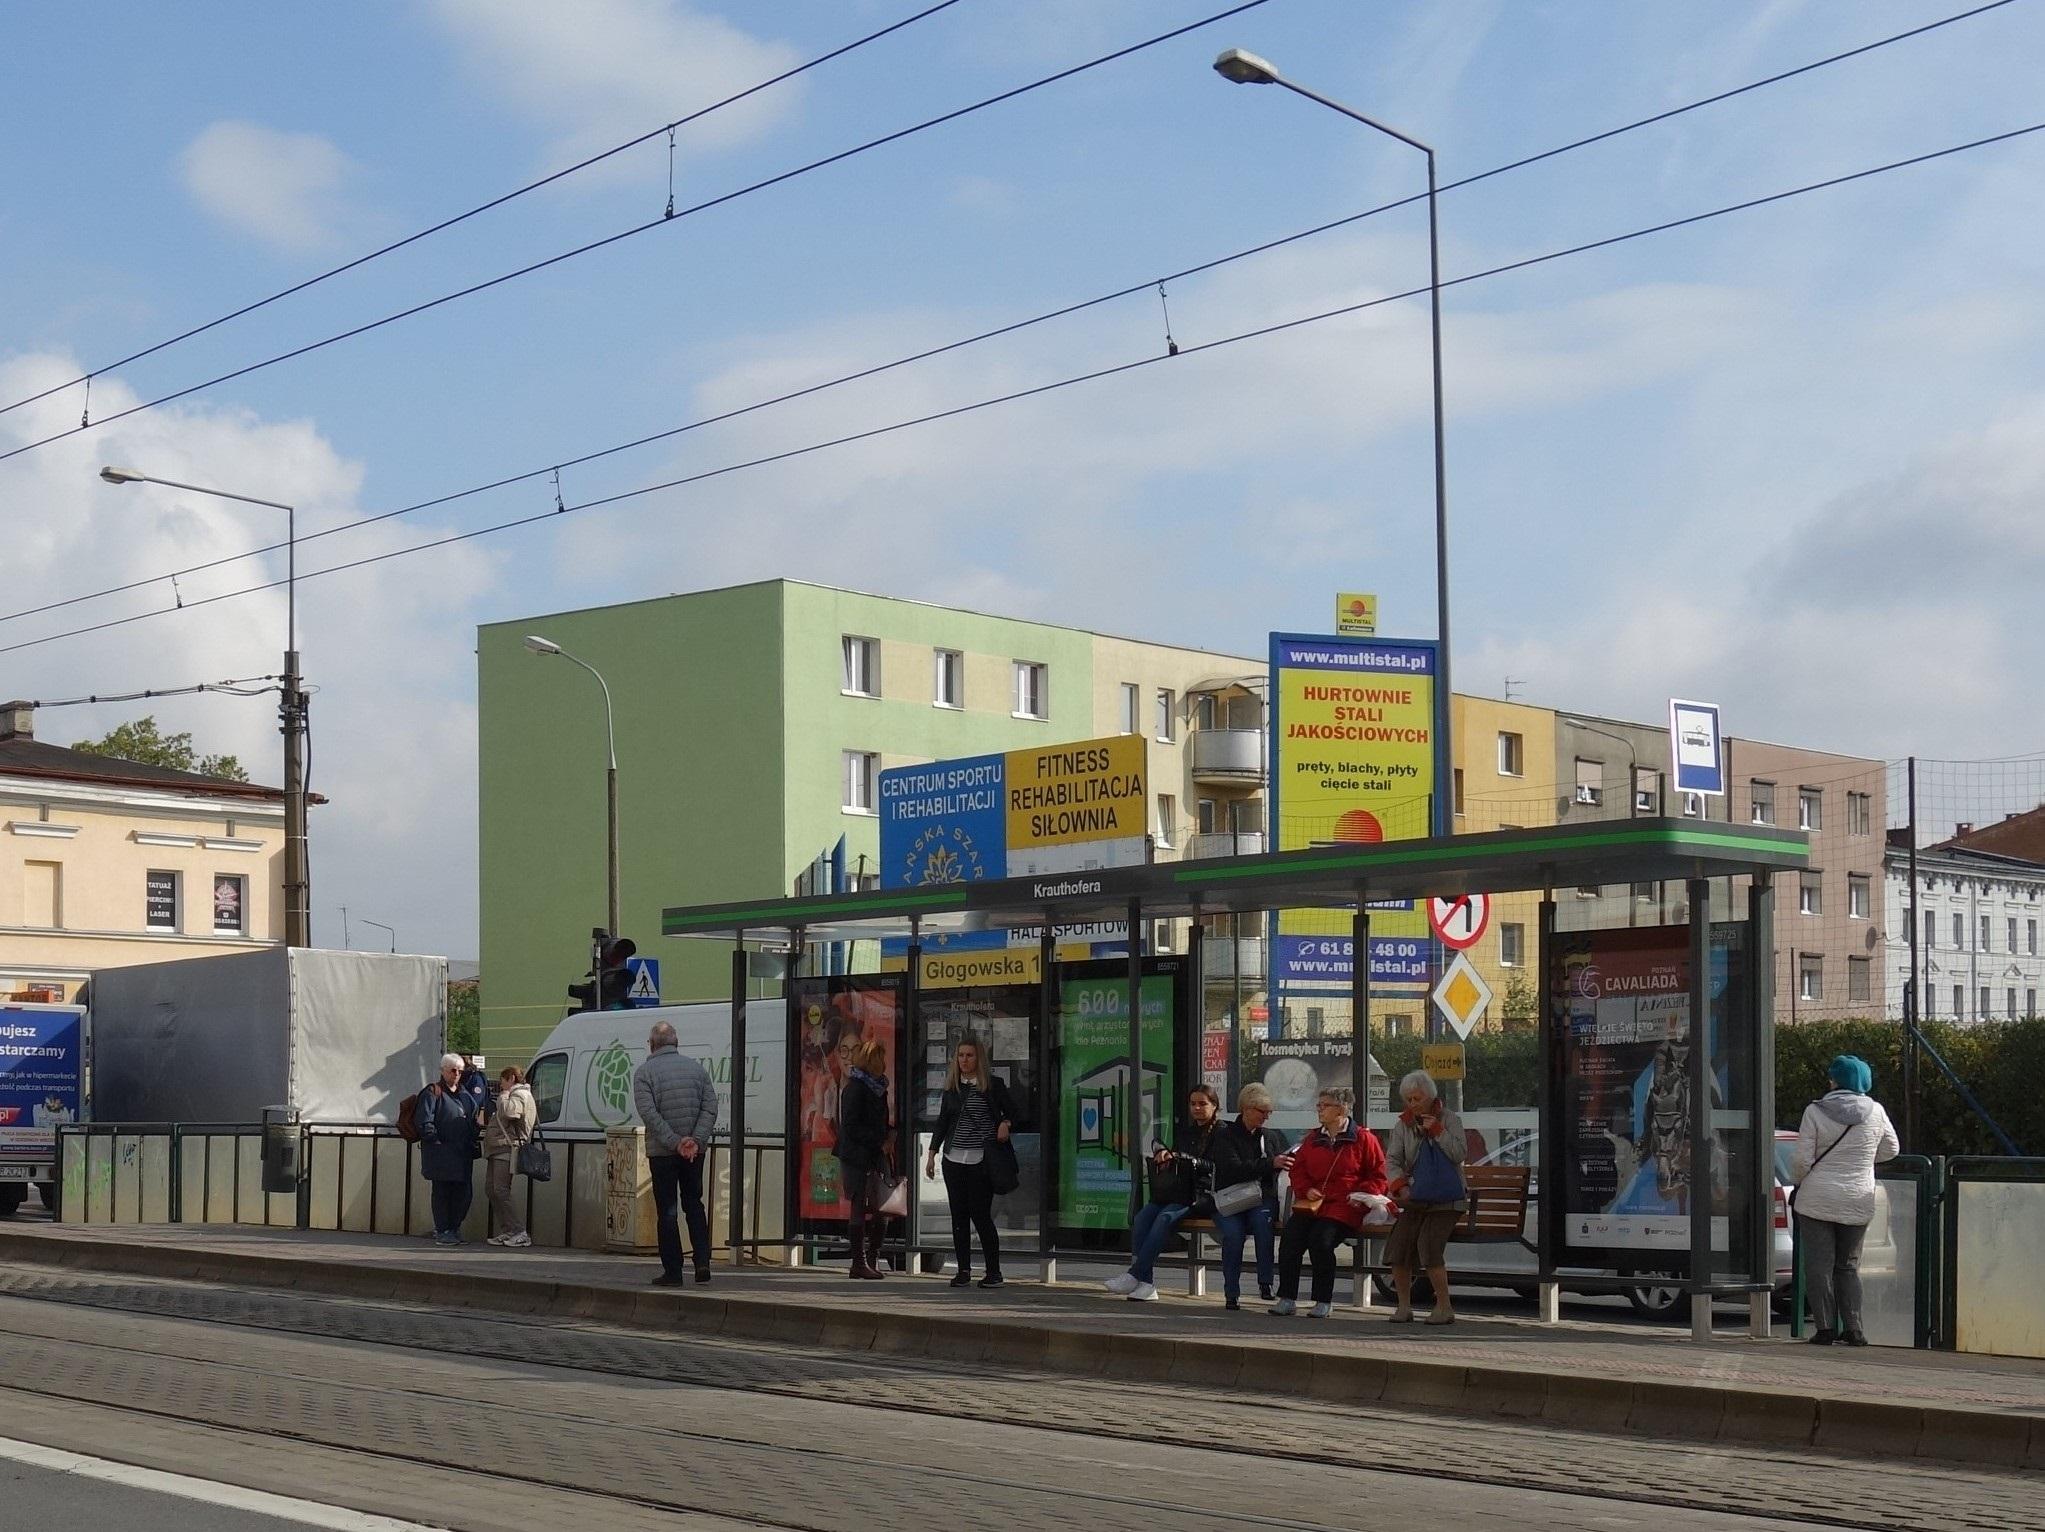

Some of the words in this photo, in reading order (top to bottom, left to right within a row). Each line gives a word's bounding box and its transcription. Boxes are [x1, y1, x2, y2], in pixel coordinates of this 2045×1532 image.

[1290, 650, 1426, 670] www.multistal.pl
[1303, 686, 1412, 705] HURTOWNIE
[1334, 706, 1383, 723] STALI
[1287, 722, 1428, 744] JAKOŚCIOWYCH
[1037, 748, 1110, 779] FITNESS
[1297, 761, 1335, 776] pręty,
[1338, 762, 1384, 777] blachy,
[1387, 763, 1418, 778] płyty
[881, 773, 946, 798] CENTRUM
[948, 764, 1002, 790] SPORTU
[1320, 778, 1360, 792] cięcie
[1363, 780, 1392, 791] stali
[1010, 774, 1143, 811] REHABILITACJA
[892, 802, 896, 820] I
[899, 790, 996, 820] REHABILITACJI
[1031, 807, 1118, 838] SIŁOWNIA
[953, 828, 984, 880] SZAR
[1033, 880, 1101, 899] Krauthofera
[1055, 920, 1129, 937] SPORTOW
[1320, 942, 1340, 956] 61
[1375, 943, 1394, 957] 48
[1398, 944, 1417, 957] 00
[926, 958, 1025, 982] Głogowska
[1031, 954, 1040, 973] 1
[1605, 974, 1679, 991] CAVALIADA
[1078, 989, 1119, 1015] 600
[0, 1024, 36, 1039] ujesz
[1579, 1023, 1617, 1033] WIELKIE
[1261, 1042, 1320, 1058] Kosmetyka
[1323, 1042, 1353, 1057] Fryzj
